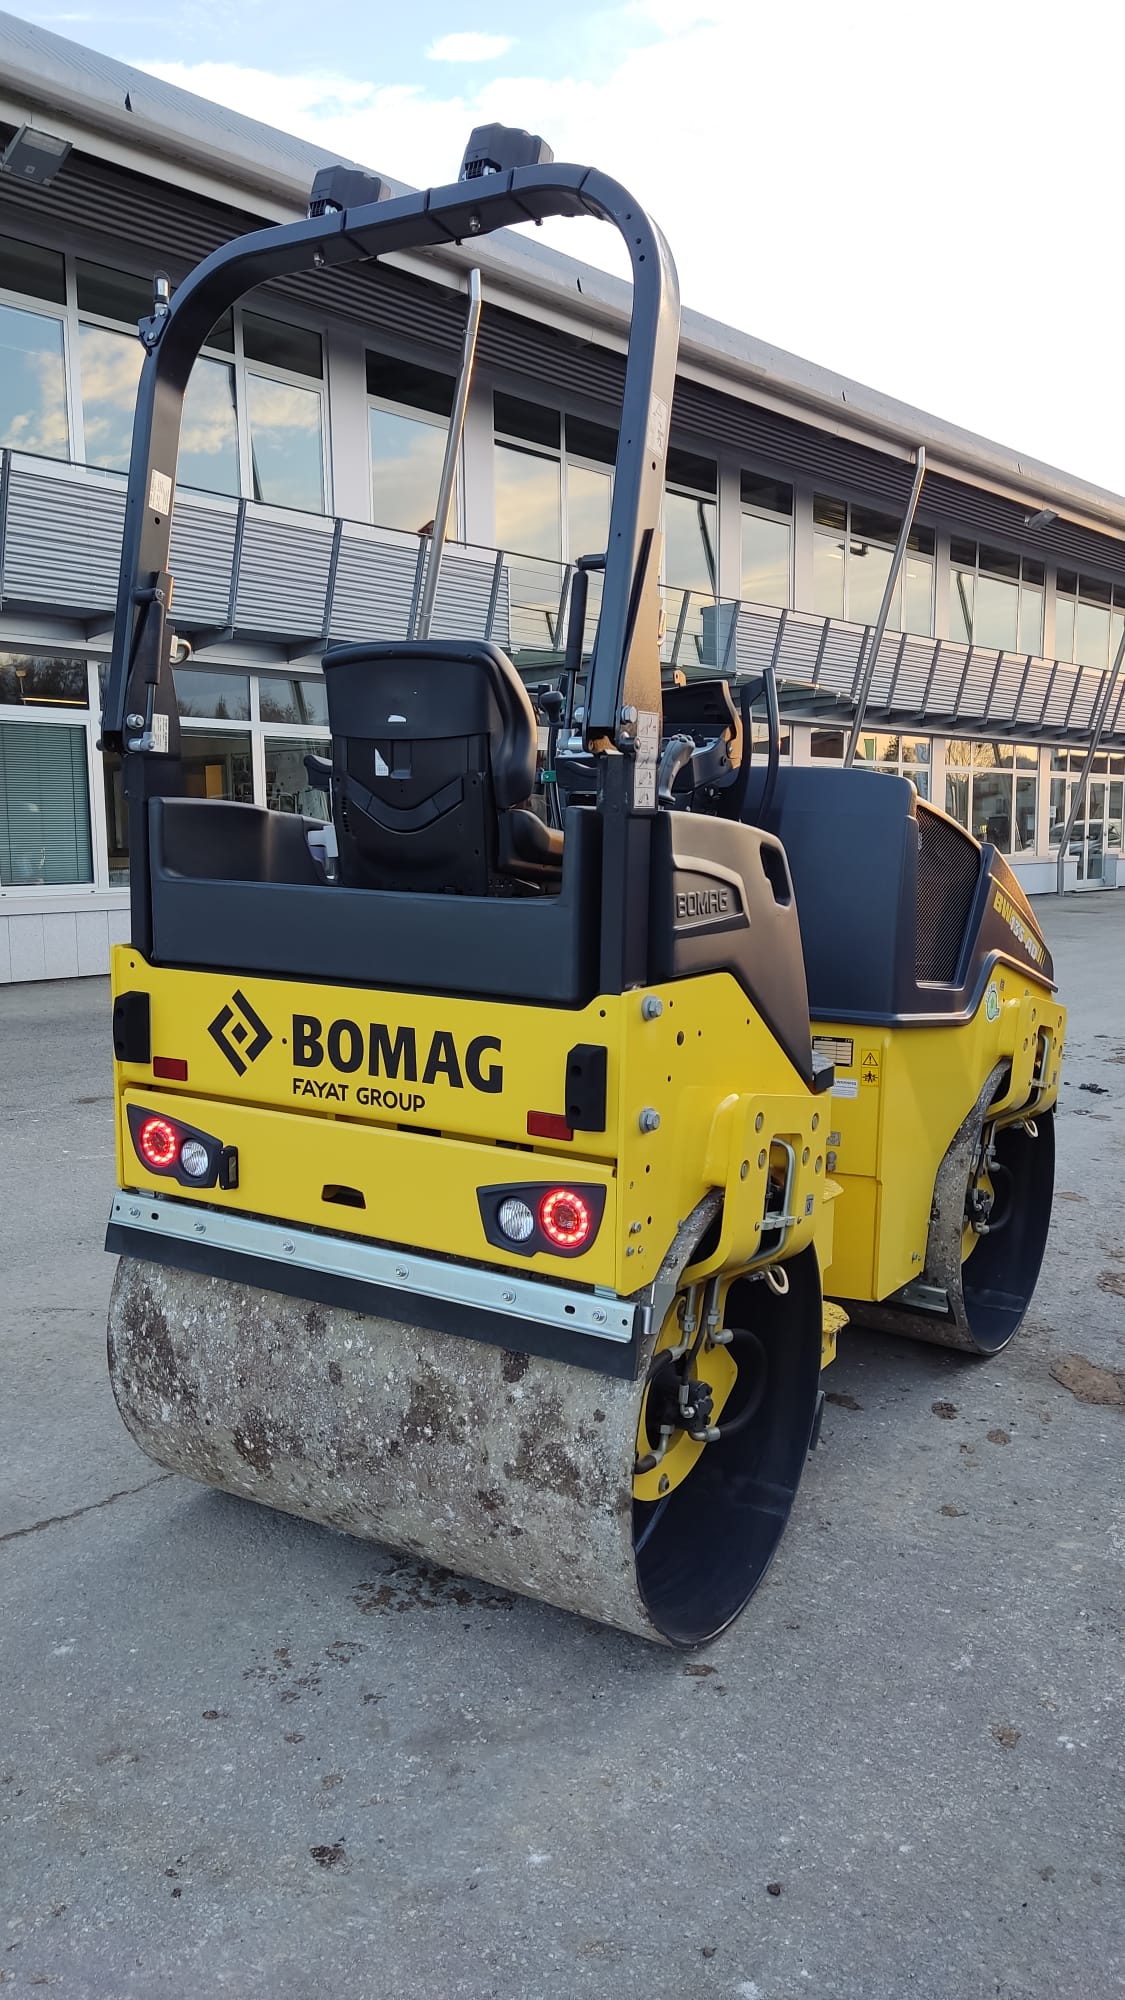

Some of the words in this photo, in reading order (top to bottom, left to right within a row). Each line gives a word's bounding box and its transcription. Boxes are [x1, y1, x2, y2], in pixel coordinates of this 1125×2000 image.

[676, 888, 728, 918] BOMAG
[292, 1013, 504, 1094] BOMAG
[292, 1077, 349, 1102] FAYAT
[356, 1087, 426, 1112] GROUP
